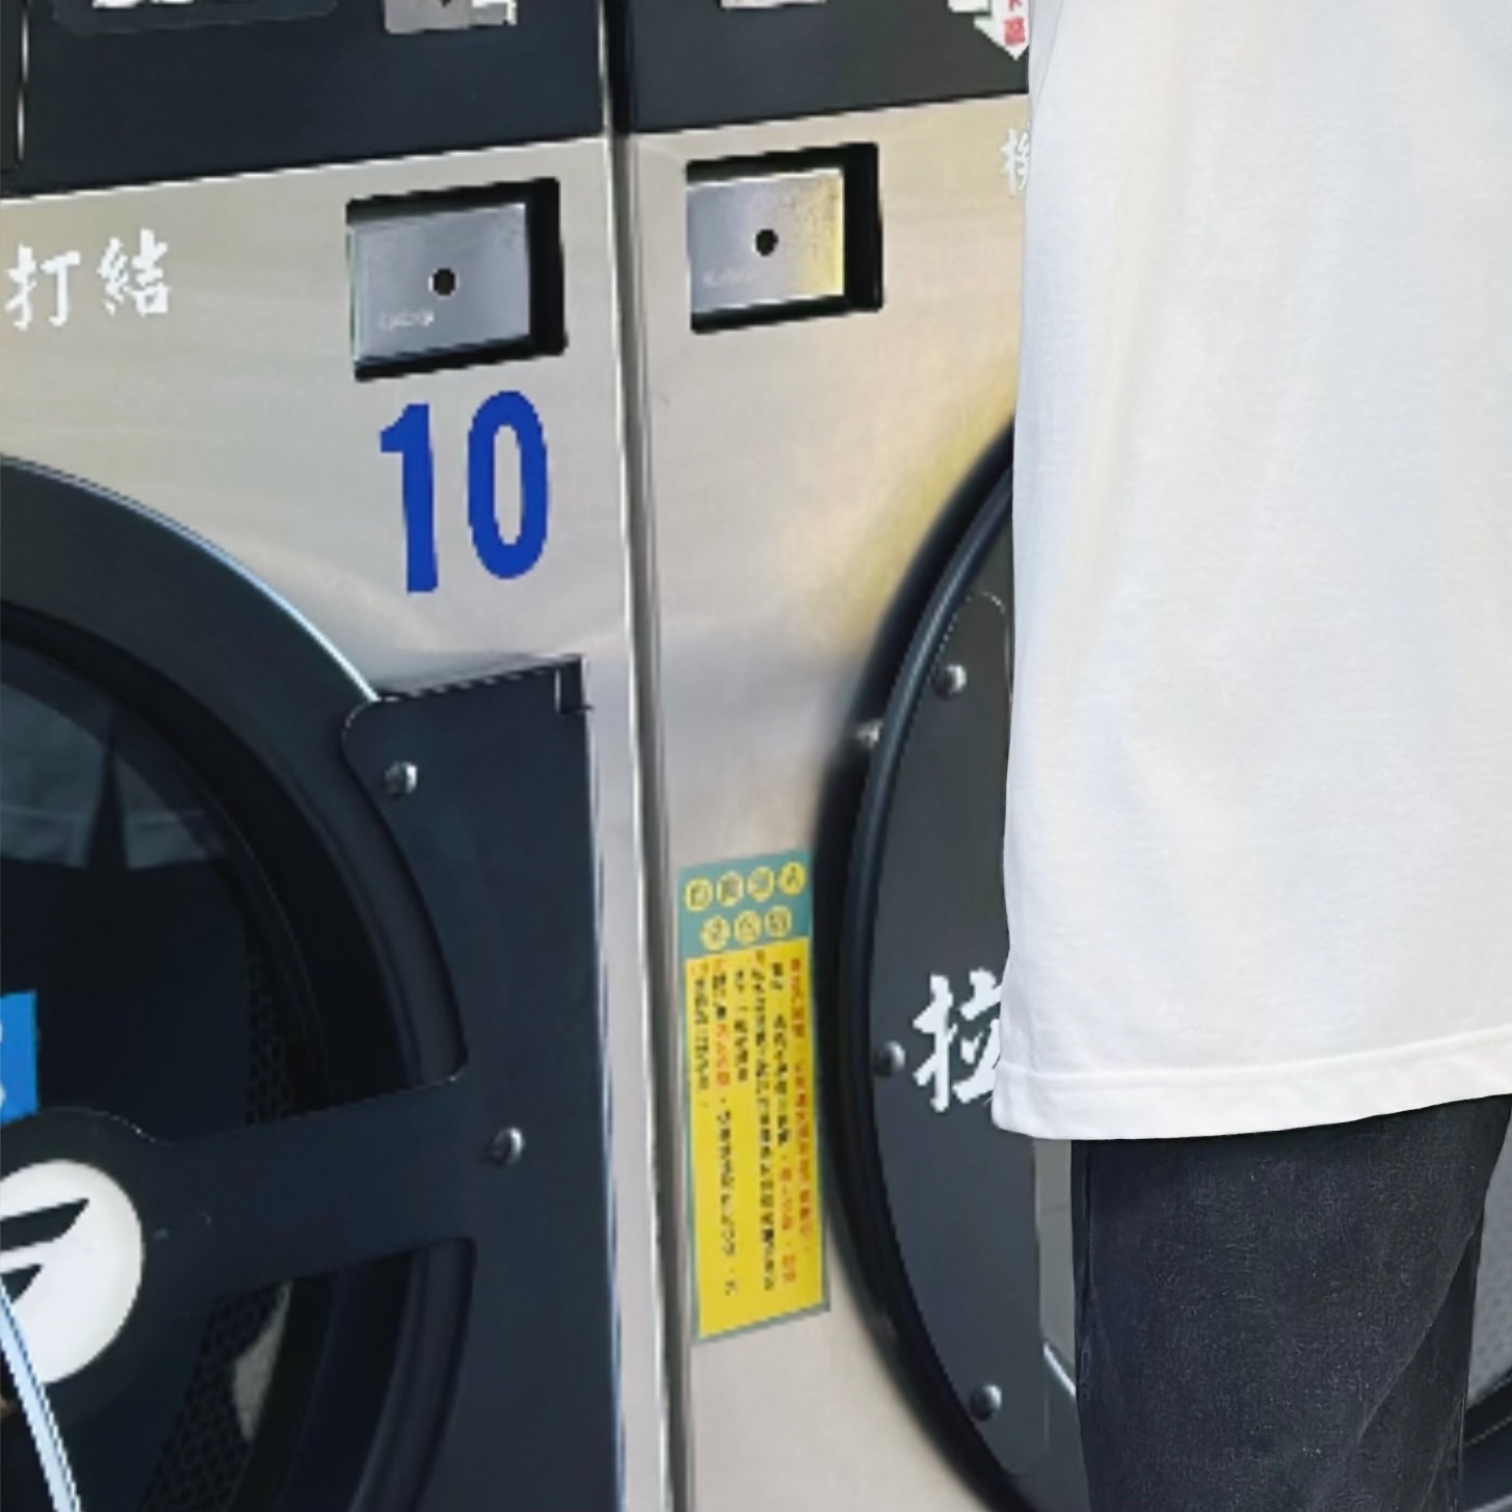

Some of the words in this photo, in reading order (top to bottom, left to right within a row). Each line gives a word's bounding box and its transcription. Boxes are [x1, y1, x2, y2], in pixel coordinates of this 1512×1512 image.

[5, 229, 170, 330] 打結
[380, 391, 549, 593] 10
[912, 966, 1001, 1113] 拉
